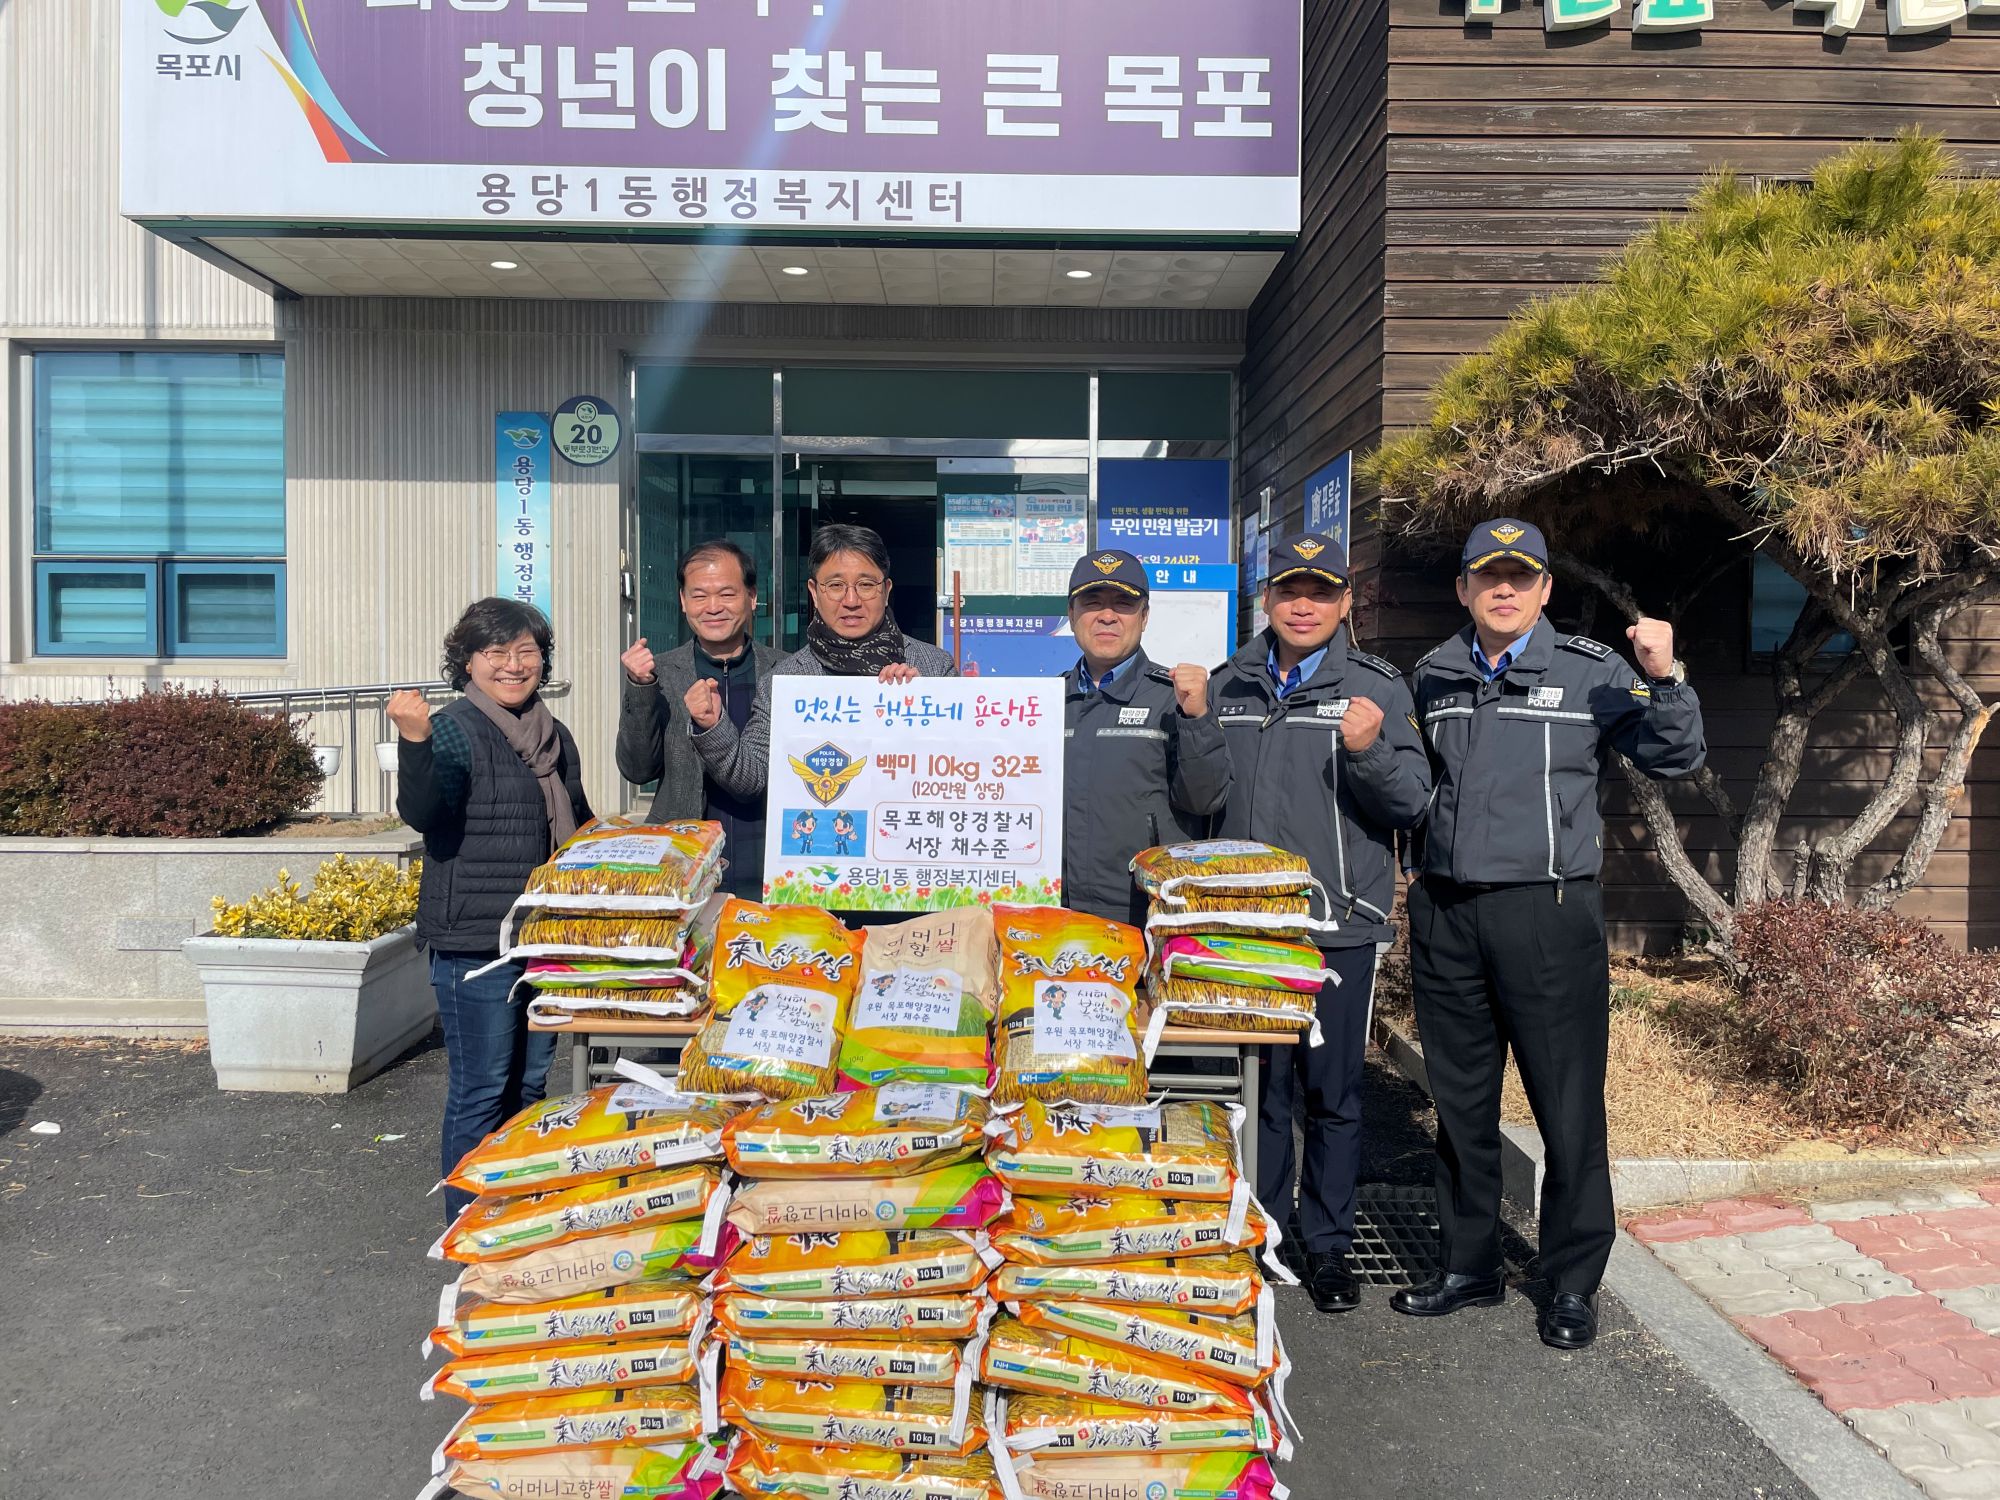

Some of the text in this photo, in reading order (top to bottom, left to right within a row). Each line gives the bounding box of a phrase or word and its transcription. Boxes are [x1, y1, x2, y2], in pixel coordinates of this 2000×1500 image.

[155, 54, 241, 81] 목포시
[464, 42, 1272, 138] 청년이 찾는 큰 목포
[477, 173, 964, 223] 용당1동행정복지센터
[570, 424, 603, 444] 20
[512, 456, 535, 536] 용당1동
[1110, 518, 1218, 536] 무인 민원 발급기
[794, 692, 1042, 727] 멋있는 행복동네 용당1동
[1527, 697, 1560, 708] POLICE
[1118, 717, 1146, 725] POLICE
[811, 756, 843, 767] 해양경찰
[876, 753, 1042, 782] 백미 10kg 32포
[912, 781, 1005, 800] (120만원 상당)
[882, 809, 1034, 834] 목포해양경찰서
[905, 836, 1010, 859] 서장 채수준
[847, 867, 1017, 889] 용당1동 행정복지센터
[1021, 1074, 1038, 1082] NH
[995, 1358, 1009, 1369] NH
[508, 1479, 614, 1499] 어머니고향쌀
